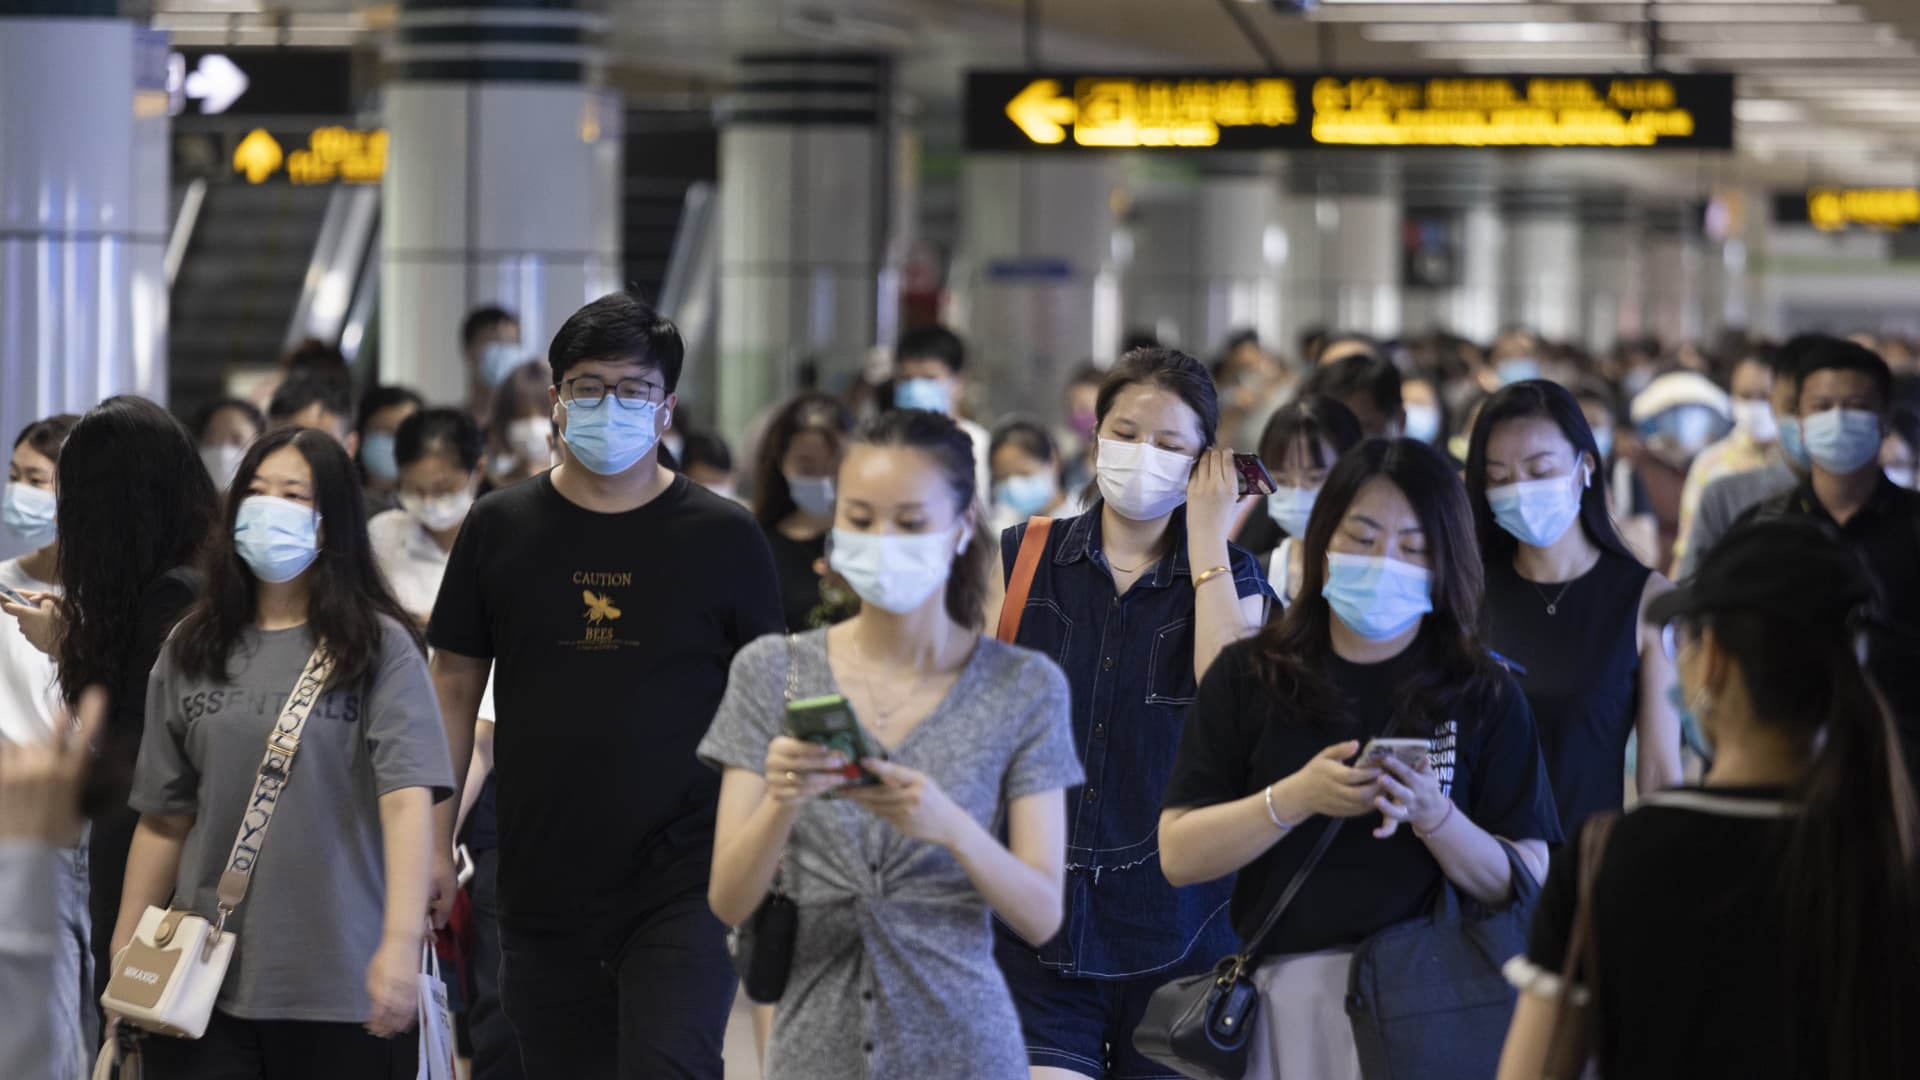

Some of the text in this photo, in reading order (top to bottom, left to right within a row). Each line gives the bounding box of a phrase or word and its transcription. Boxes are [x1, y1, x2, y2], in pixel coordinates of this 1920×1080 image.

[573, 571, 631, 587] CAUTION
[585, 627, 613, 641] BEES
[1430, 735, 1456, 751] YOUR
